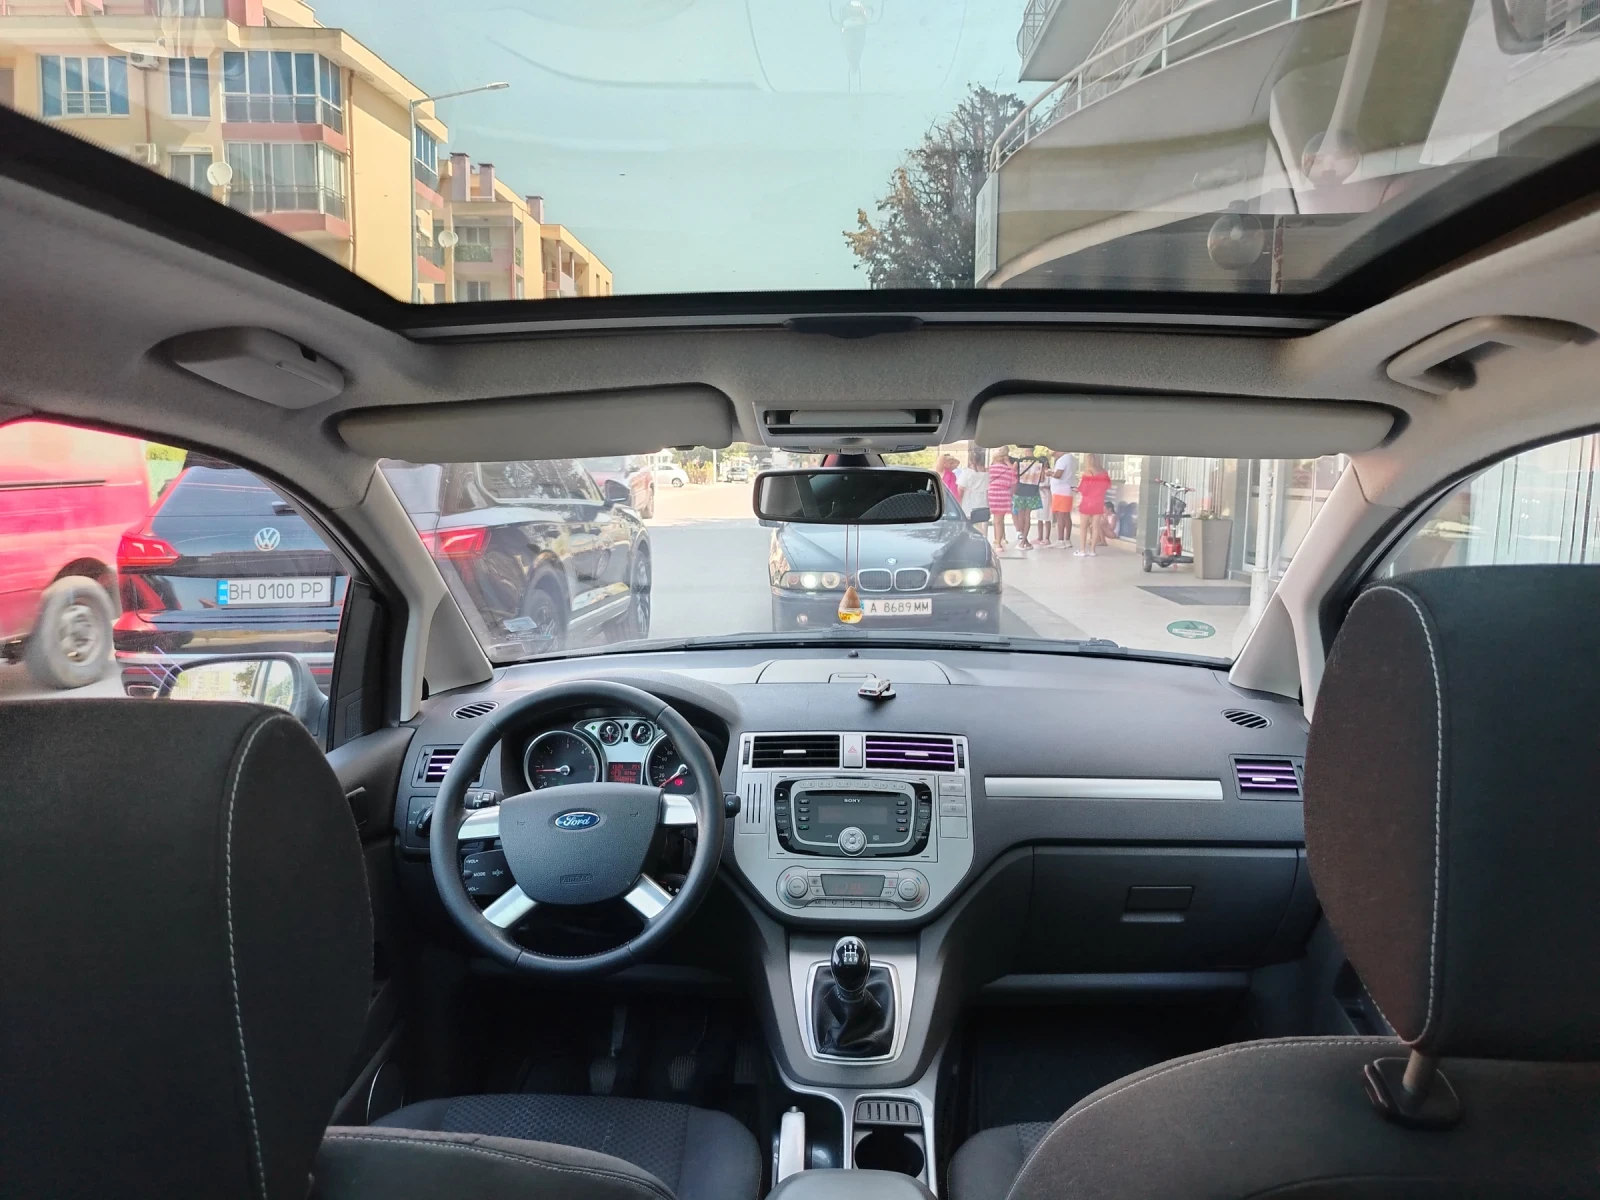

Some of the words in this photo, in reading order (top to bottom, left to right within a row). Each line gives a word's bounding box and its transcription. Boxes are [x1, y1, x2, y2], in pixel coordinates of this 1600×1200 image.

[229, 584, 252, 601] BH
[258, 583, 295, 600] 0100
[301, 582, 324, 599] PP
[870, 602, 877, 613] A
[883, 601, 912, 613] 8689
[914, 601, 929, 612] MM
[562, 813, 592, 827] Ford
